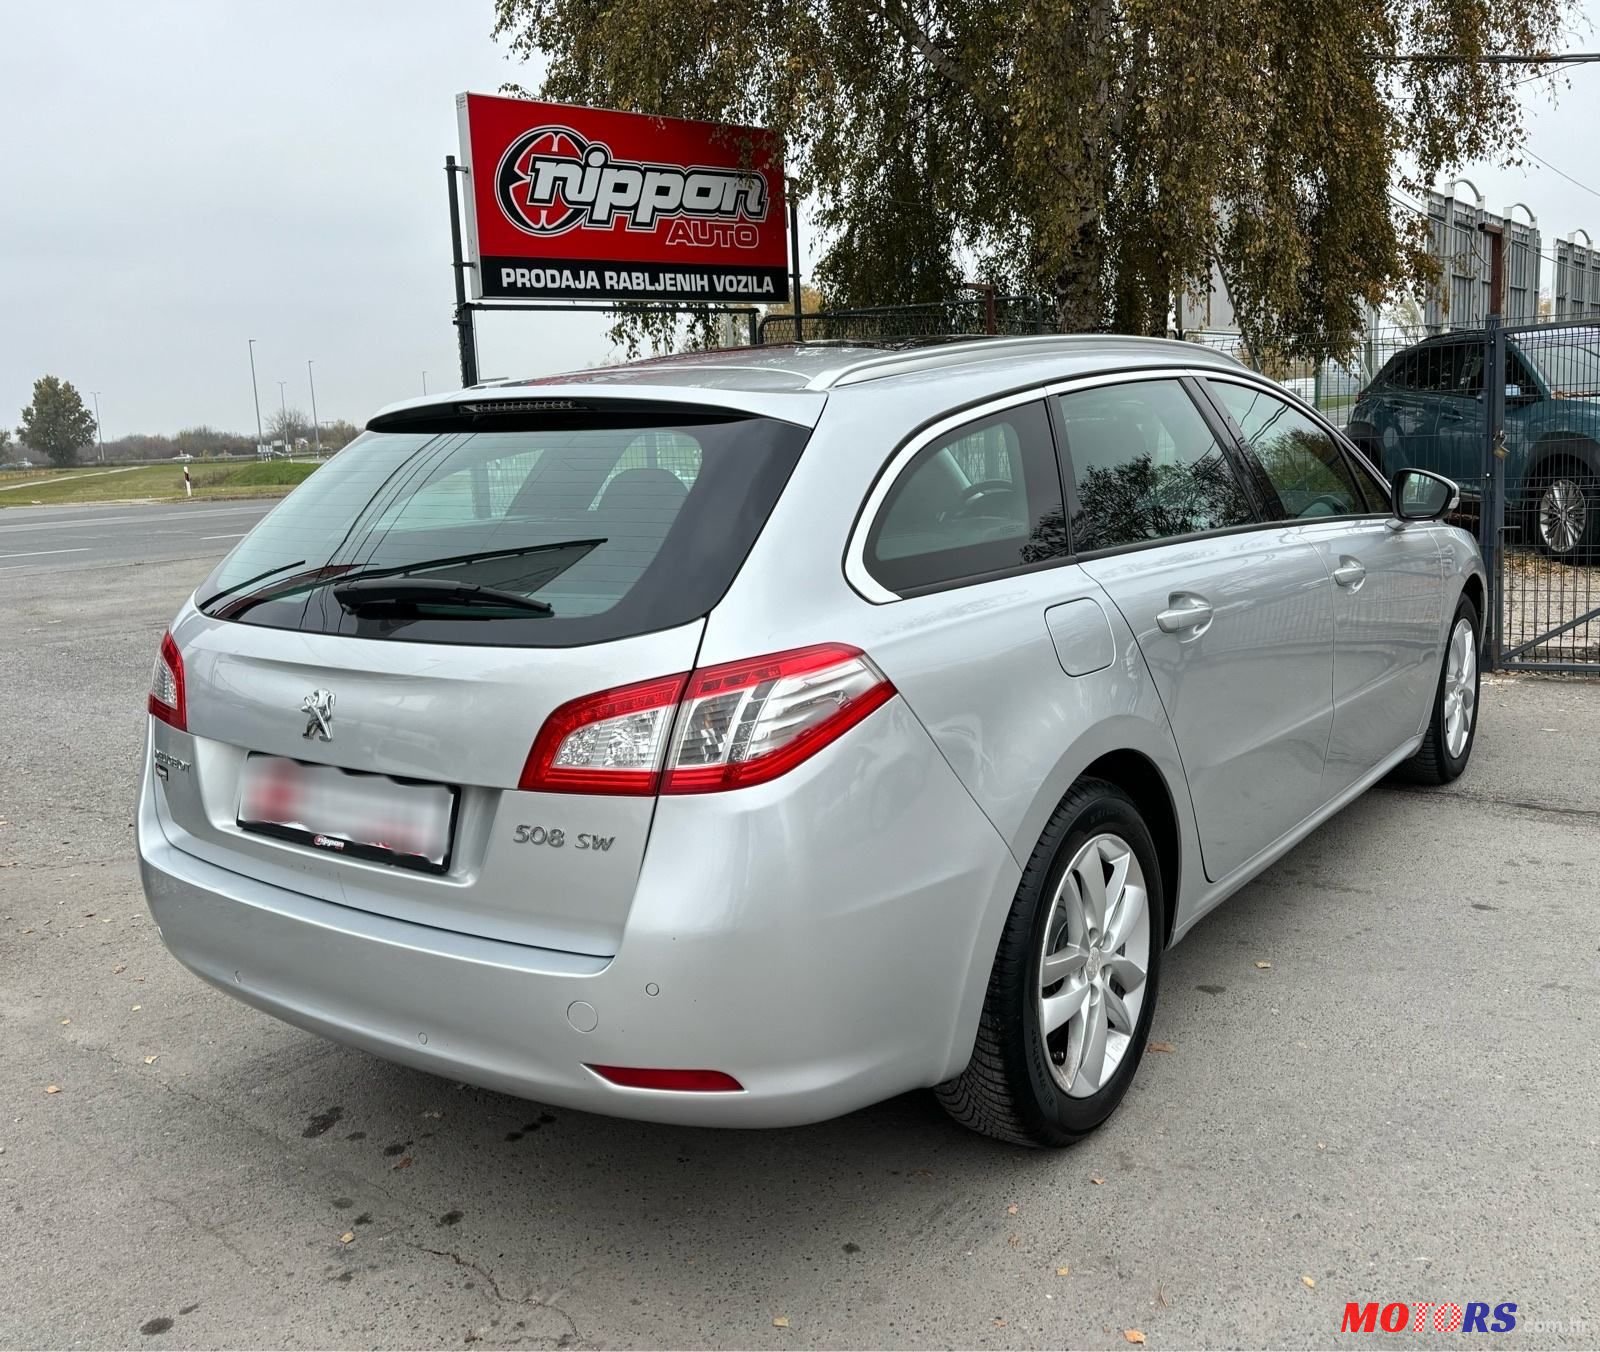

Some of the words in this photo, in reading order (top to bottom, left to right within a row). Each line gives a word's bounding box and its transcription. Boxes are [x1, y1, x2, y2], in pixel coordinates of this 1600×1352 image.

[529, 145, 769, 231] nippon
[665, 219, 759, 249] AUTO
[500, 267, 601, 290] PRODAJA
[604, 271, 709, 292] RABLJENIH
[712, 274, 775, 293] VOZILA
[512, 824, 565, 848] 508
[574, 833, 616, 851] SW
